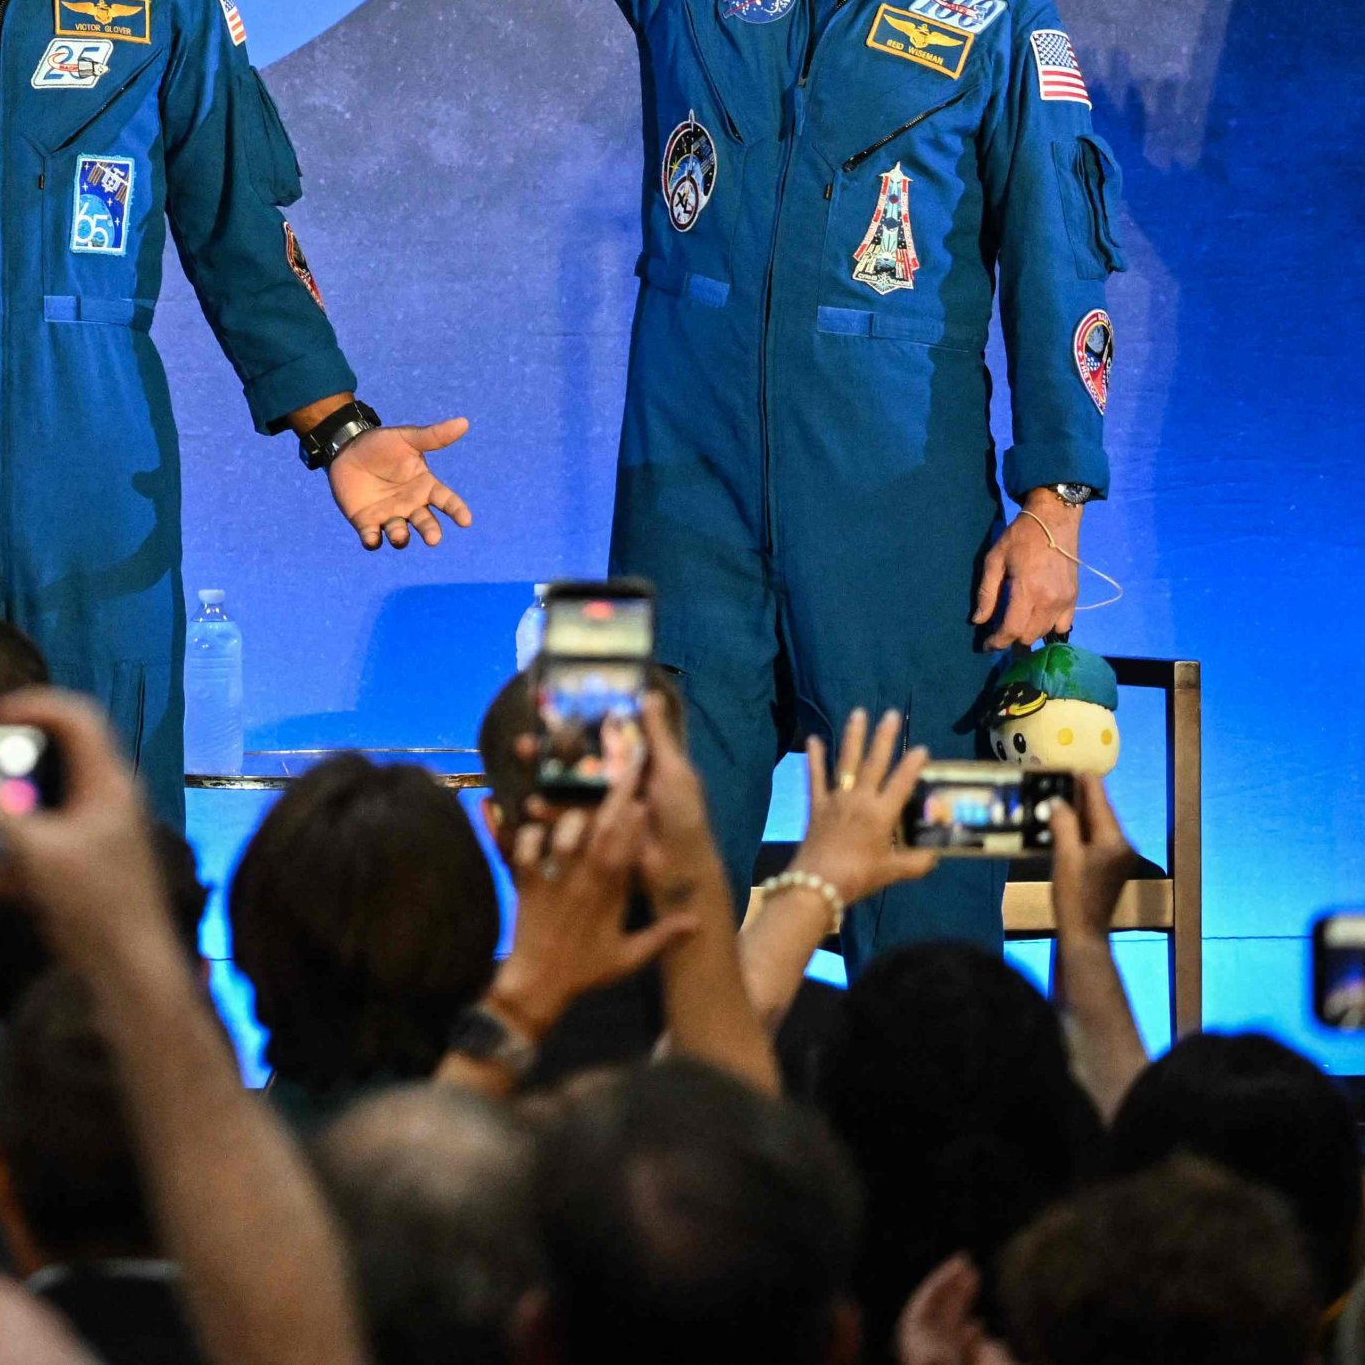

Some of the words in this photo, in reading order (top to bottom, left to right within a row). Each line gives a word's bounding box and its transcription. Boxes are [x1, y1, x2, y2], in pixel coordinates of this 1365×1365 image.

[75, 23, 101, 32] VICTOR
[104, 25, 132, 35] GLOVER
[43, 45, 101, 80] 25
[886, 39, 905, 51] REID
[908, 45, 945, 65] WISEMAN
[75, 201, 109, 247] 65
